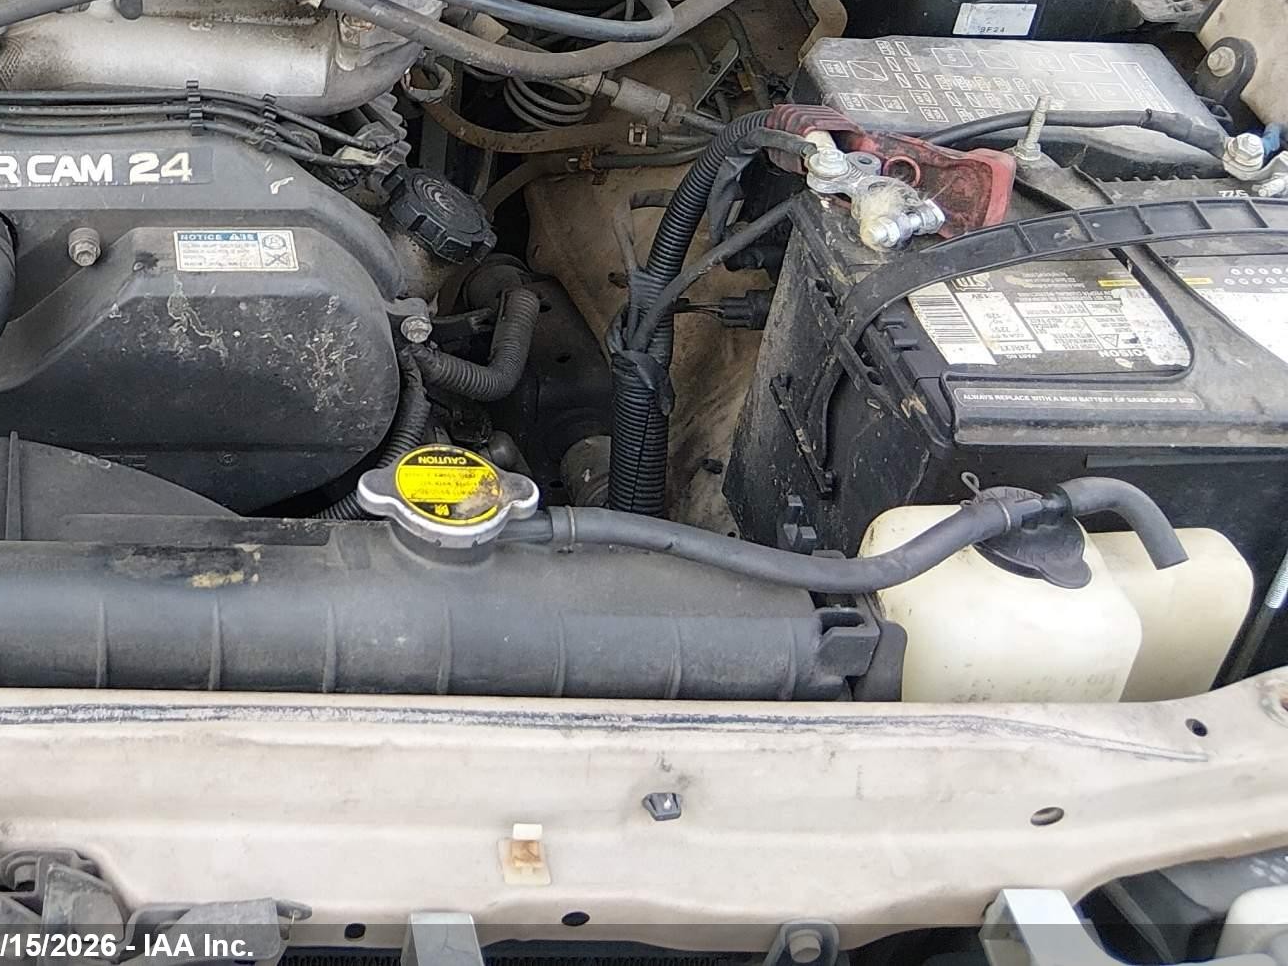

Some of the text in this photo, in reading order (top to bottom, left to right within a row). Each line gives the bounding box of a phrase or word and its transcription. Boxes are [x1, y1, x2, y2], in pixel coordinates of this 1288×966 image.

[27, 153, 113, 184] CAM
[128, 151, 193, 183] 24
[180, 233, 223, 241] NOTICE
[1098, 348, 1148, 358] OISON
[417, 455, 467, 465] CAUTION
